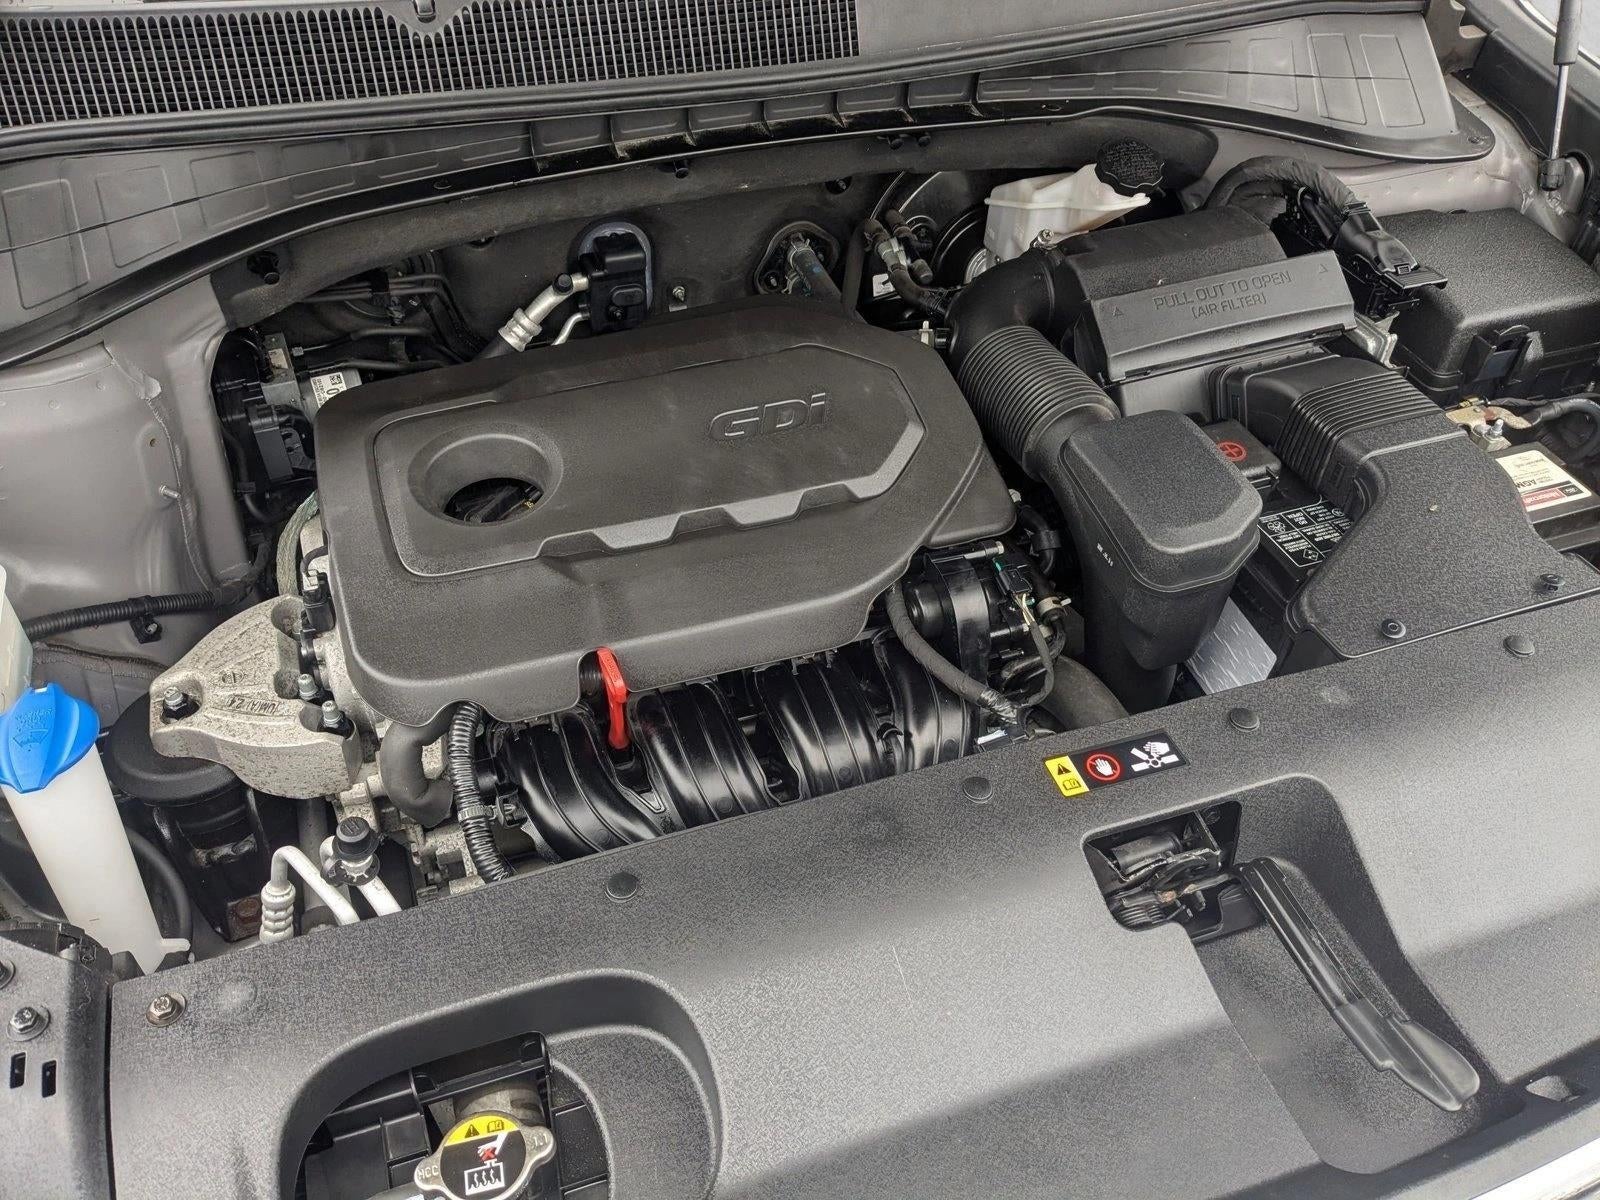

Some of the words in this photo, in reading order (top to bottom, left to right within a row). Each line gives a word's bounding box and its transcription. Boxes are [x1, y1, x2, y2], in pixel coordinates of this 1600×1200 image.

[1153, 291, 1194, 310] PULL
[1195, 283, 1227, 300] OUT
[1227, 279, 1249, 294] TO
[1251, 270, 1292, 289] OPEN
[707, 392, 826, 438] GDi
